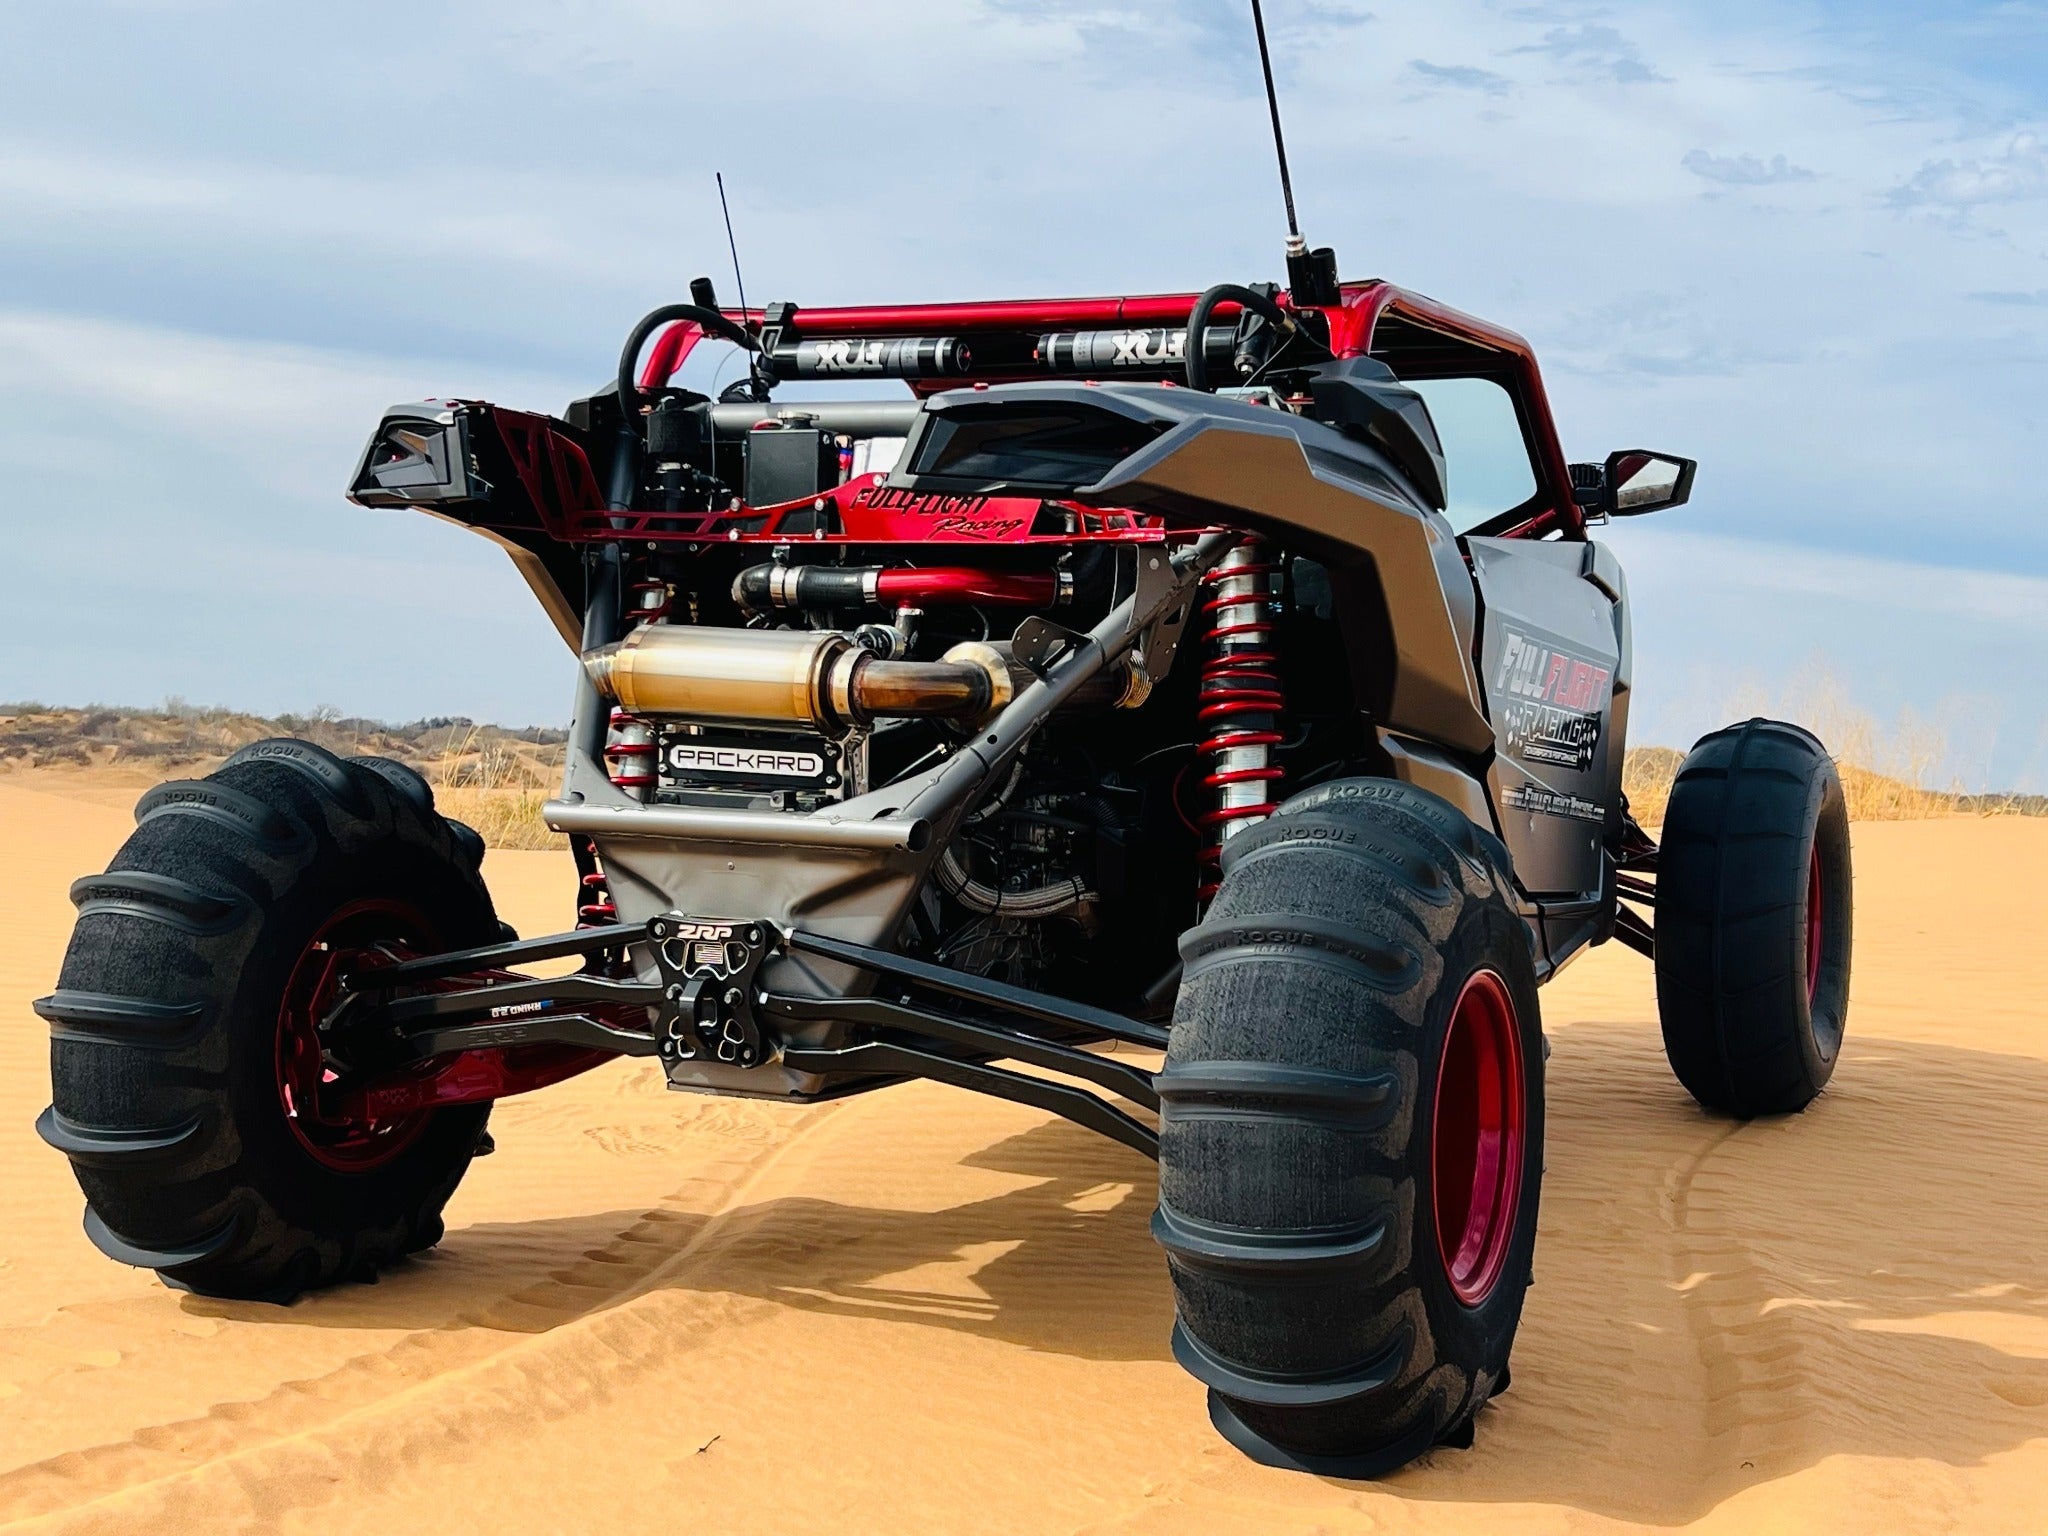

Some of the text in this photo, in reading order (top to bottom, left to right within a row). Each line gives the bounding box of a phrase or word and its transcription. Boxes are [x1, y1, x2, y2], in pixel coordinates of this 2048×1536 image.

[815, 338, 884, 372] FOX
[1111, 328, 1187, 366] FOX
[928, 516, 1025, 539] Racing
[1520, 701, 1584, 746] RACING
[678, 749, 816, 772] PACKARD
[1328, 785, 1405, 802] ROGUE
[1279, 824, 1358, 844] ROGUE
[677, 924, 733, 941] ZRP
[1232, 929, 1315, 946] ROGUE
[509, 1002, 542, 1015] RHINO
